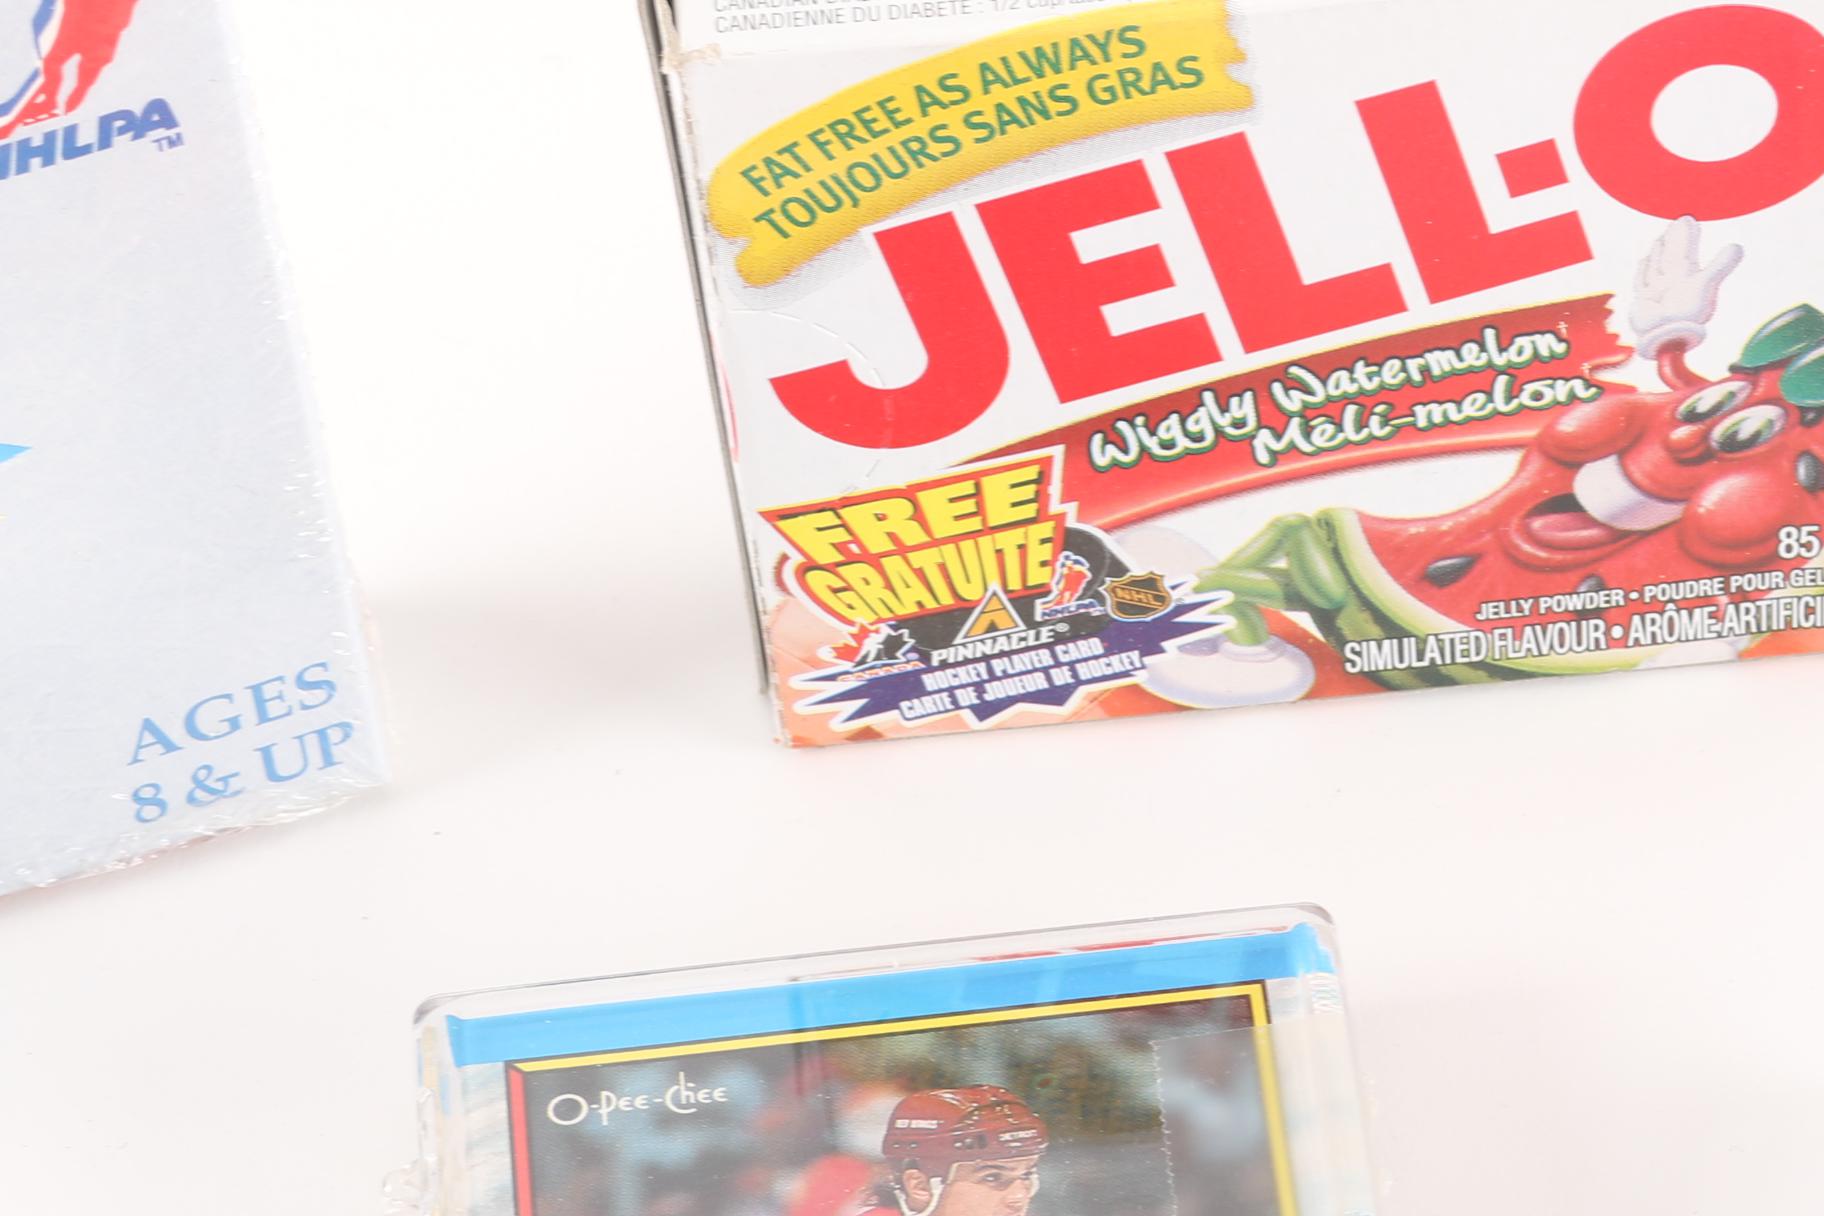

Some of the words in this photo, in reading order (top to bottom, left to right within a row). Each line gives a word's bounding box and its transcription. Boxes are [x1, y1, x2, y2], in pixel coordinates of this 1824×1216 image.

[715, 7, 845, 34] CANADIENNE
[852, 4, 882, 23] DU
[740, 142, 818, 199] FAT
[809, 93, 914, 162] FREE
[918, 72, 971, 119] AS
[981, 23, 1149, 97] ALWAYS
[753, 125, 965, 240] TOUJOURS
[971, 83, 1082, 146] SANS
[1087, 54, 1207, 108] GRAS
[1088, 388, 1260, 471] Wiggly
[1272, 325, 1567, 414] Watermelon
[773, 465, 1042, 564] FREE
[1778, 526, 1821, 560] 85
[804, 520, 1056, 622] GRATUITE
[1115, 585, 1164, 613] NHL
[1475, 599, 1534, 621] JELLY
[1539, 588, 1625, 614] POWDER
[1644, 579, 1725, 606] POUDRE
[1730, 573, 1784, 596] POUR
[923, 662, 987, 692] HOCKEY
[993, 650, 1052, 684] PLAYER
[1057, 638, 1104, 668] CARD
[930, 628, 1055, 666] PINNACLE
[1344, 630, 1489, 675] SIMULATED
[1493, 620, 1607, 662] FLAVOUR
[1627, 603, 1720, 649] ARÔME
[127, 661, 338, 767] AGES
[900, 694, 953, 721] CARTE
[958, 689, 980, 709] DE
[984, 673, 1048, 702] JOUEUR
[1052, 669, 1074, 689] DE
[1076, 650, 1143, 681] HOCKEY
[133, 782, 168, 824] 8
[186, 763, 246, 808] &
[253, 720, 354, 784] UP
